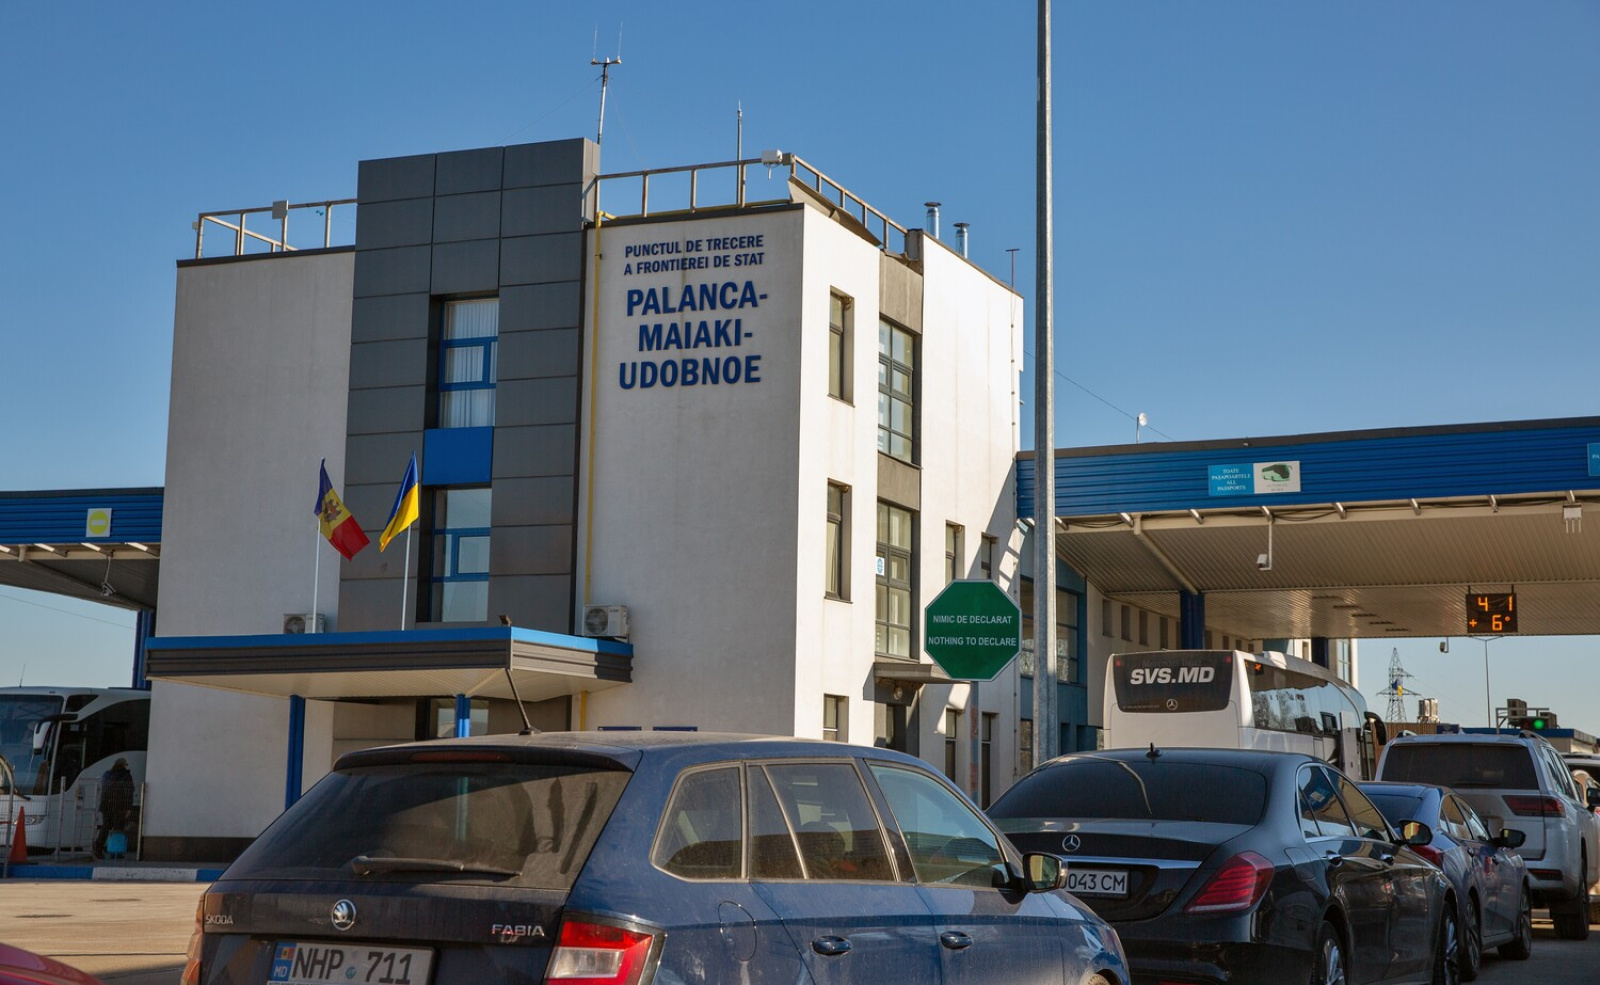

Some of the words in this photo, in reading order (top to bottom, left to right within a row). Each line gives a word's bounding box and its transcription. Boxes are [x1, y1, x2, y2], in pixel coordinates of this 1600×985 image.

[625, 241, 682, 258] PUNCTUL
[686, 239, 703, 253] DE
[706, 235, 764, 251] TRECERE
[623, 263, 633, 276] A
[636, 256, 709, 275] FRONTIEREI
[713, 255, 731, 268] DE
[734, 252, 765, 266] STAT
[627, 280, 768, 317] PALANCA-
[638, 318, 753, 352] MAIAKI-
[619, 355, 762, 390] UDOBNOE
[932, 615, 955, 624] NIMIC
[956, 615, 968, 624] DE
[969, 615, 1013, 624] DECLARAT
[928, 636, 964, 646] NOTHING
[965, 636, 977, 645] TO
[978, 637, 1017, 646] DECLARE
[1130, 666, 1215, 685] SVS.MD
[1062, 873, 1097, 890] 043
[1101, 874, 1126, 892] CM
[491, 924, 545, 937] FABIA
[273, 965, 288, 978] MD
[291, 948, 345, 980] NHP
[365, 951, 413, 985] 711
